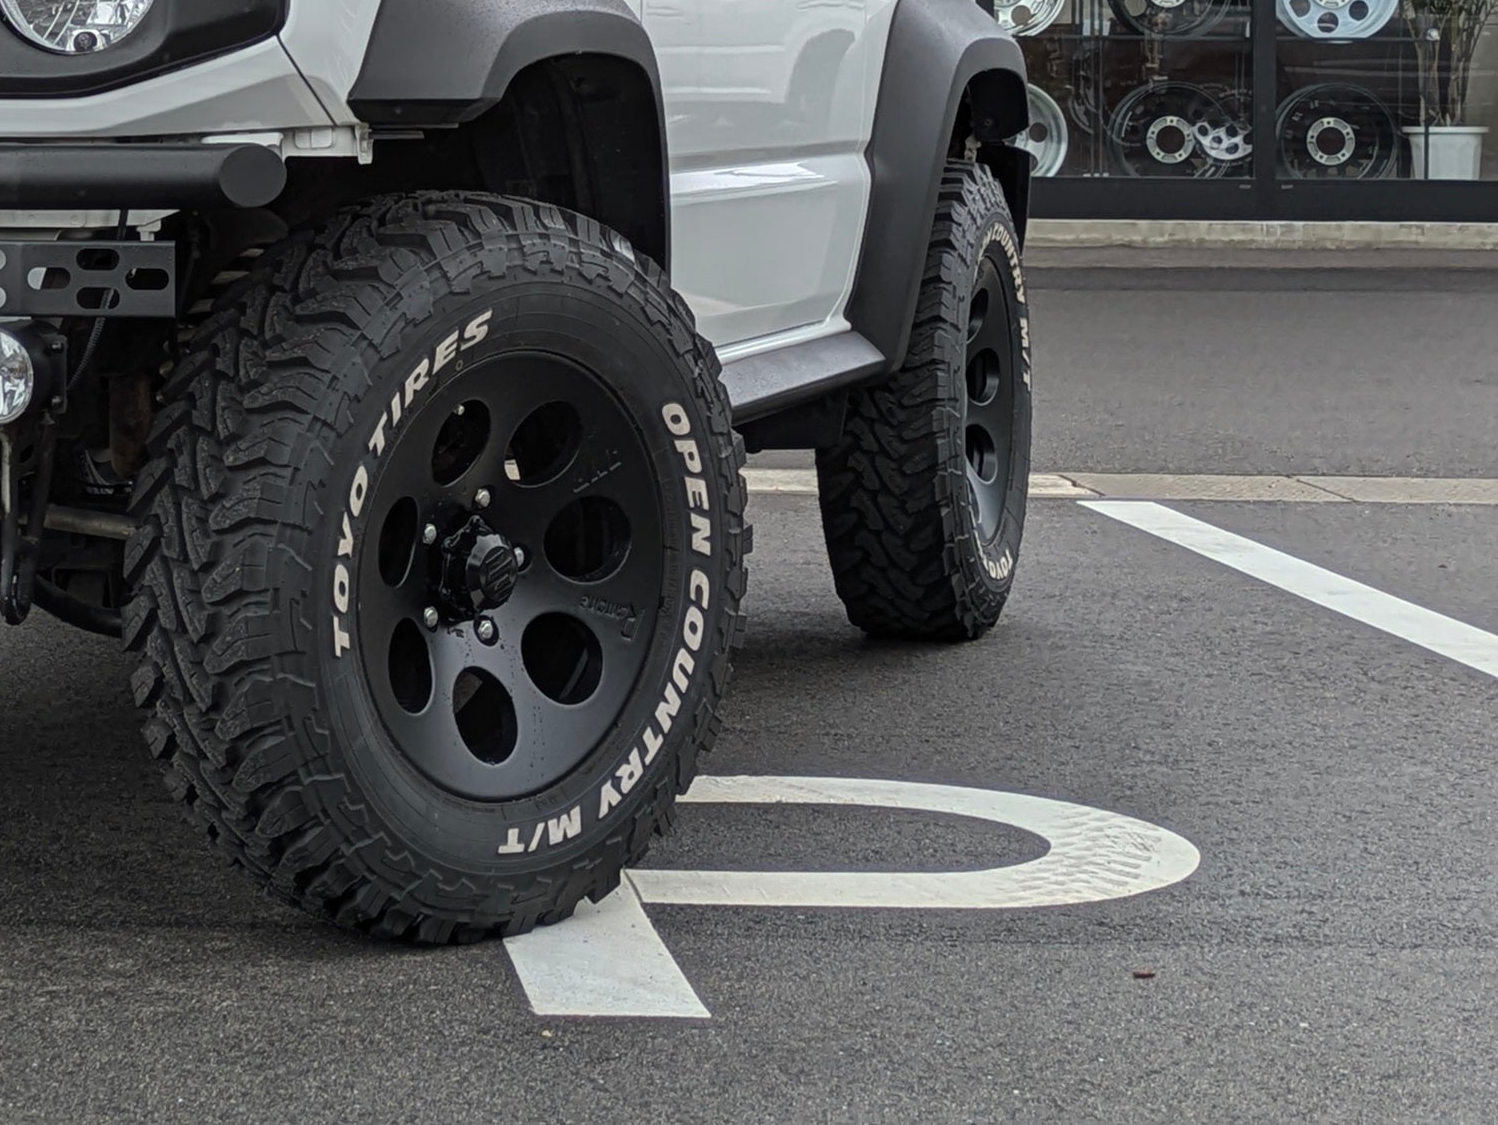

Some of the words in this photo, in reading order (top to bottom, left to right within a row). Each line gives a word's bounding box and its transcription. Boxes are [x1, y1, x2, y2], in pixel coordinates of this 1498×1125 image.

[332, 465, 369, 659] TOYO
[368, 309, 493, 457] TIRES
[661, 402, 712, 556] OPEN
[598, 569, 710, 820] COUNTRY
[497, 805, 582, 855] M/T
